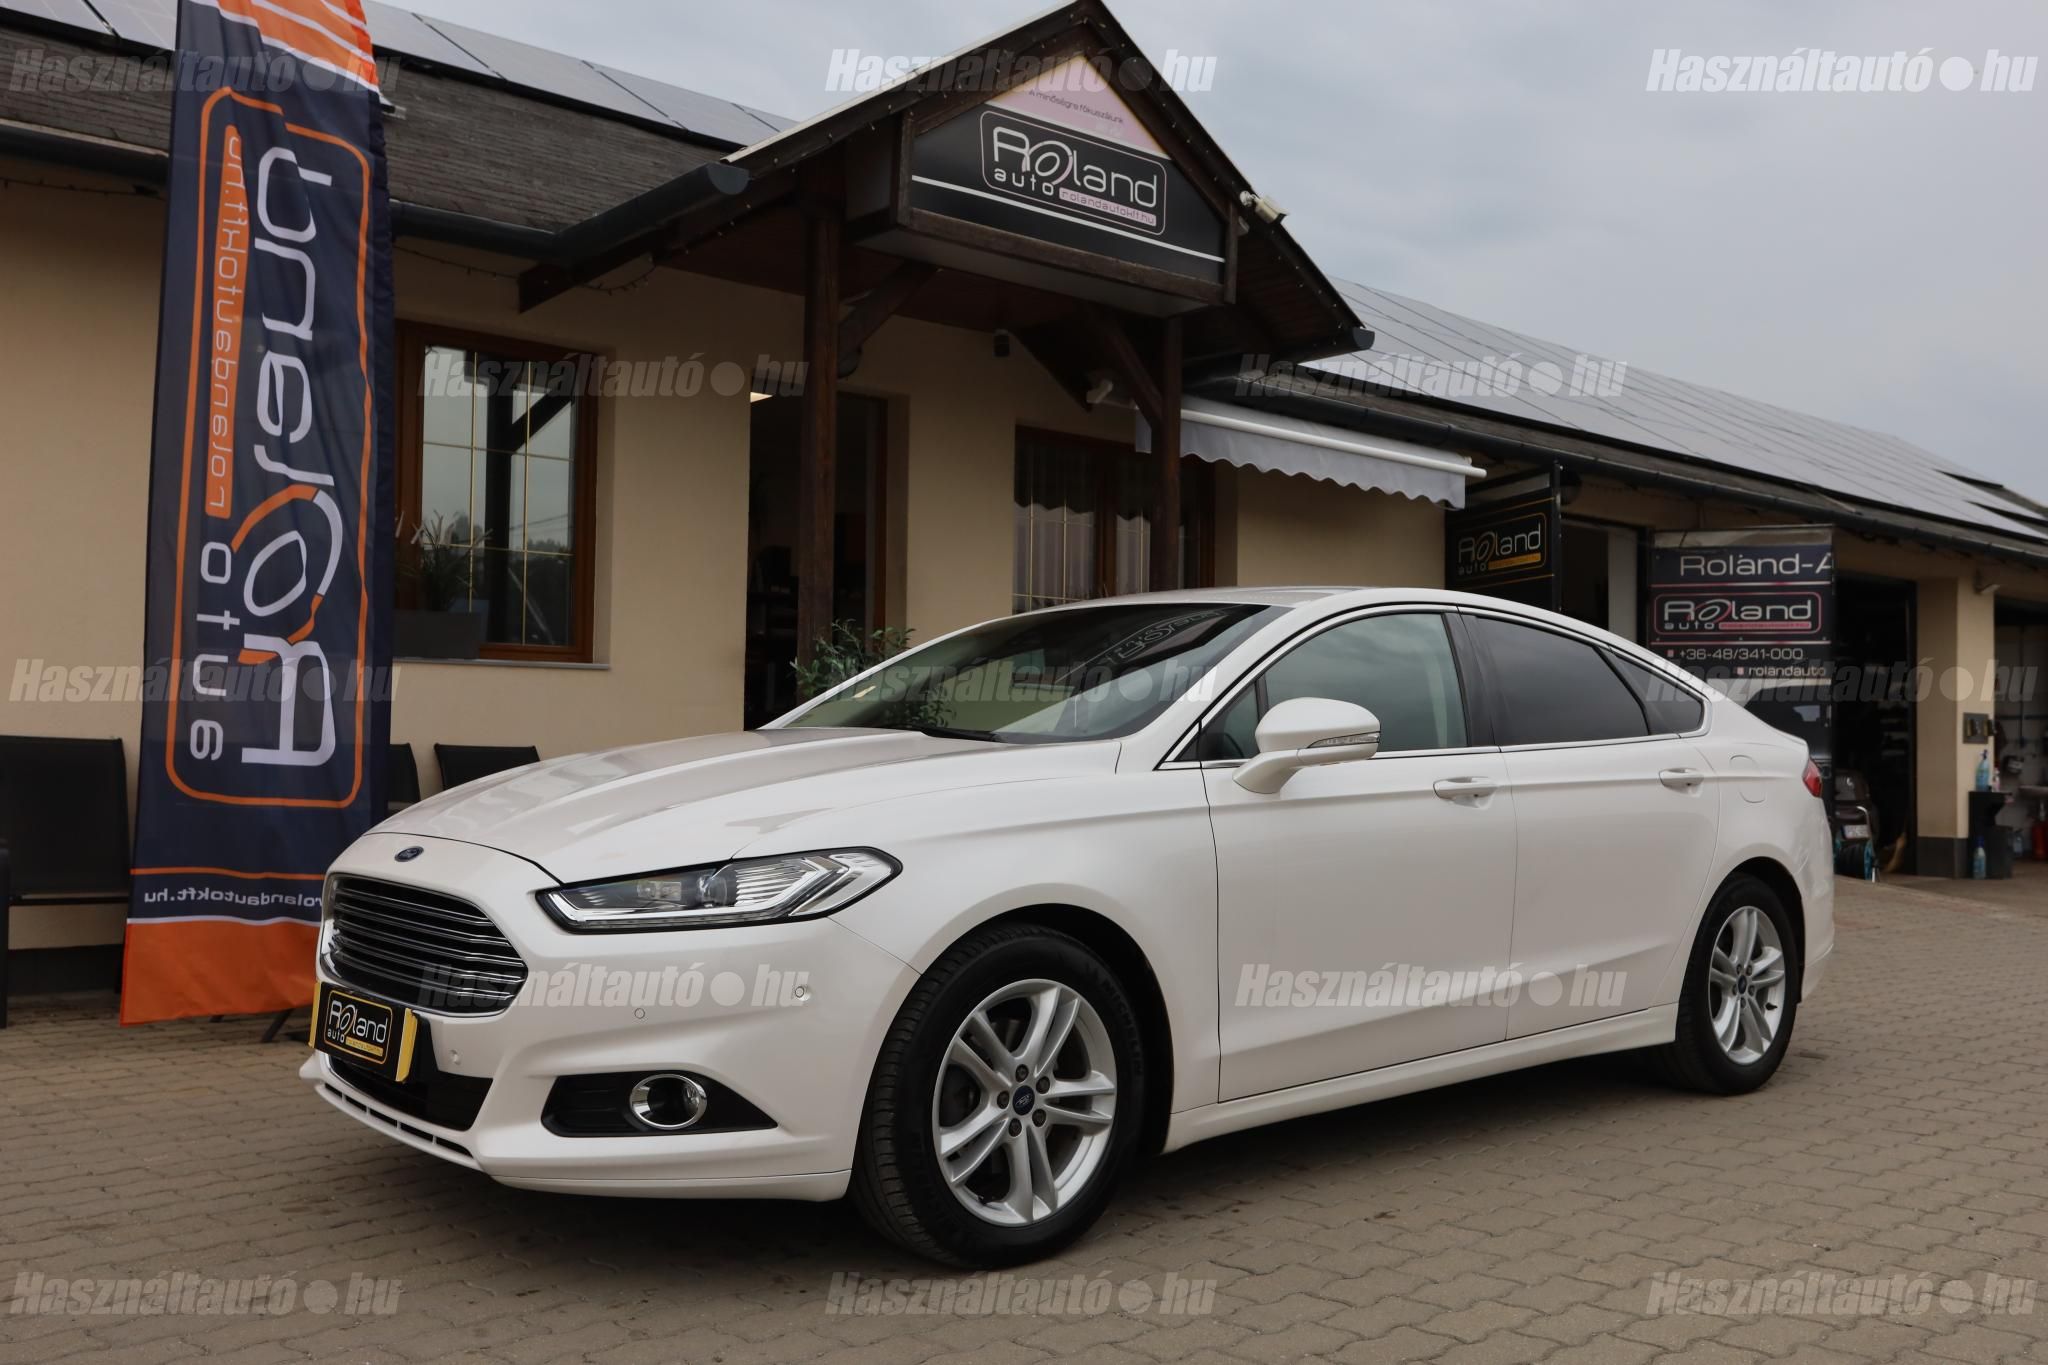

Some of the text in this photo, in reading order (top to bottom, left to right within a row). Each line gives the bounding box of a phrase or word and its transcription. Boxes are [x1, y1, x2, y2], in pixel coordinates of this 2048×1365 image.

[993, 126, 1157, 208] Roland
[994, 167, 1054, 196] auto
[1458, 521, 1541, 563] Roland
[1664, 599, 1812, 623] Roland
[1664, 621, 1715, 630] auto
[1680, 647, 1803, 660] +36-48/341-000
[328, 1000, 388, 1043] Roland
[327, 1028, 345, 1043] auto
